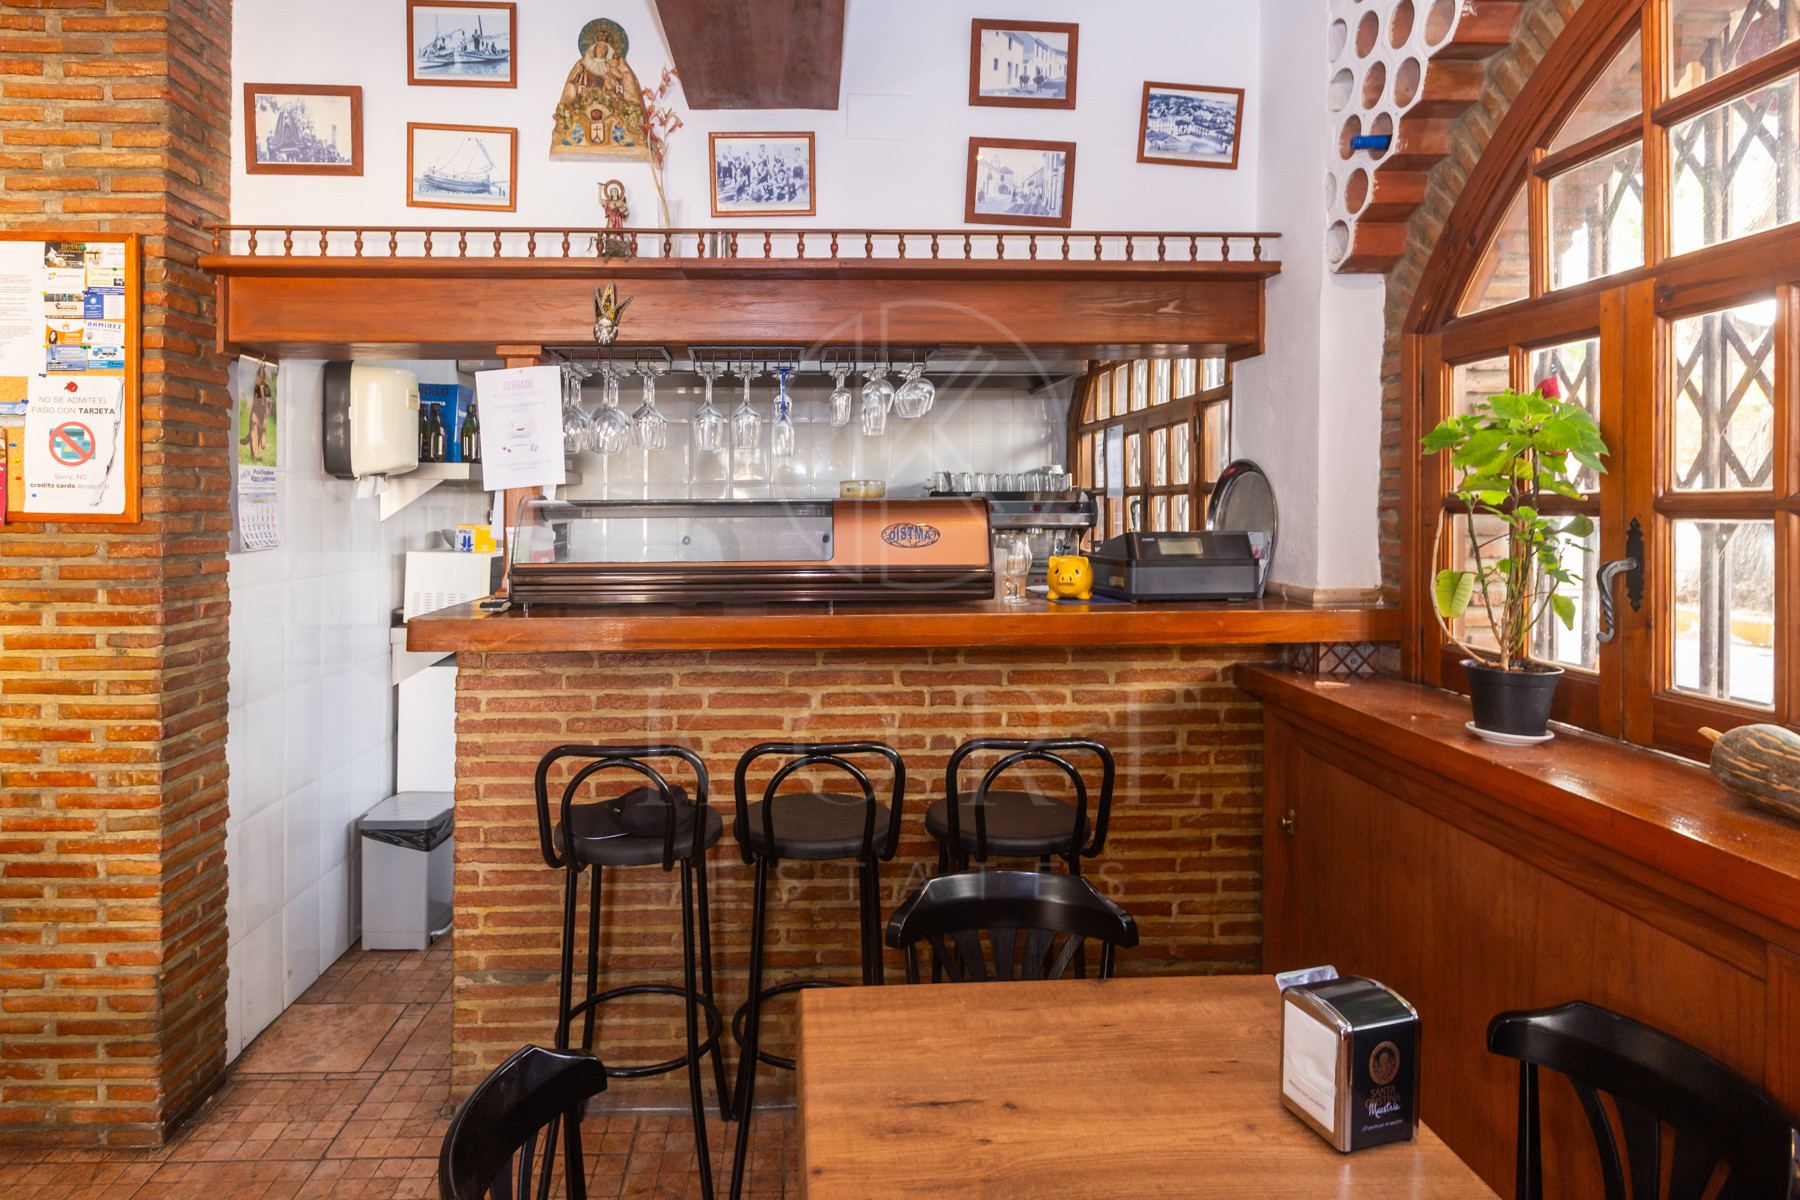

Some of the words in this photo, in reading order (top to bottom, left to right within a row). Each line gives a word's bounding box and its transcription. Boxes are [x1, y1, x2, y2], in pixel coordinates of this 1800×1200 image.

[87, 321, 122, 330] RAMIREZ
[503, 379, 534, 391] CERRADO
[38, 396, 52, 404] NO
[53, 396, 65, 404] SE
[66, 396, 97, 404] ADMITE
[98, 397, 109, 405] EL
[31, 406, 55, 414] PAGO
[57, 406, 76, 414] CON
[78, 407, 115, 415] TARJETA
[889, 526, 932, 541] DISTMA
[1370, 1085, 1397, 1098] SANTA
